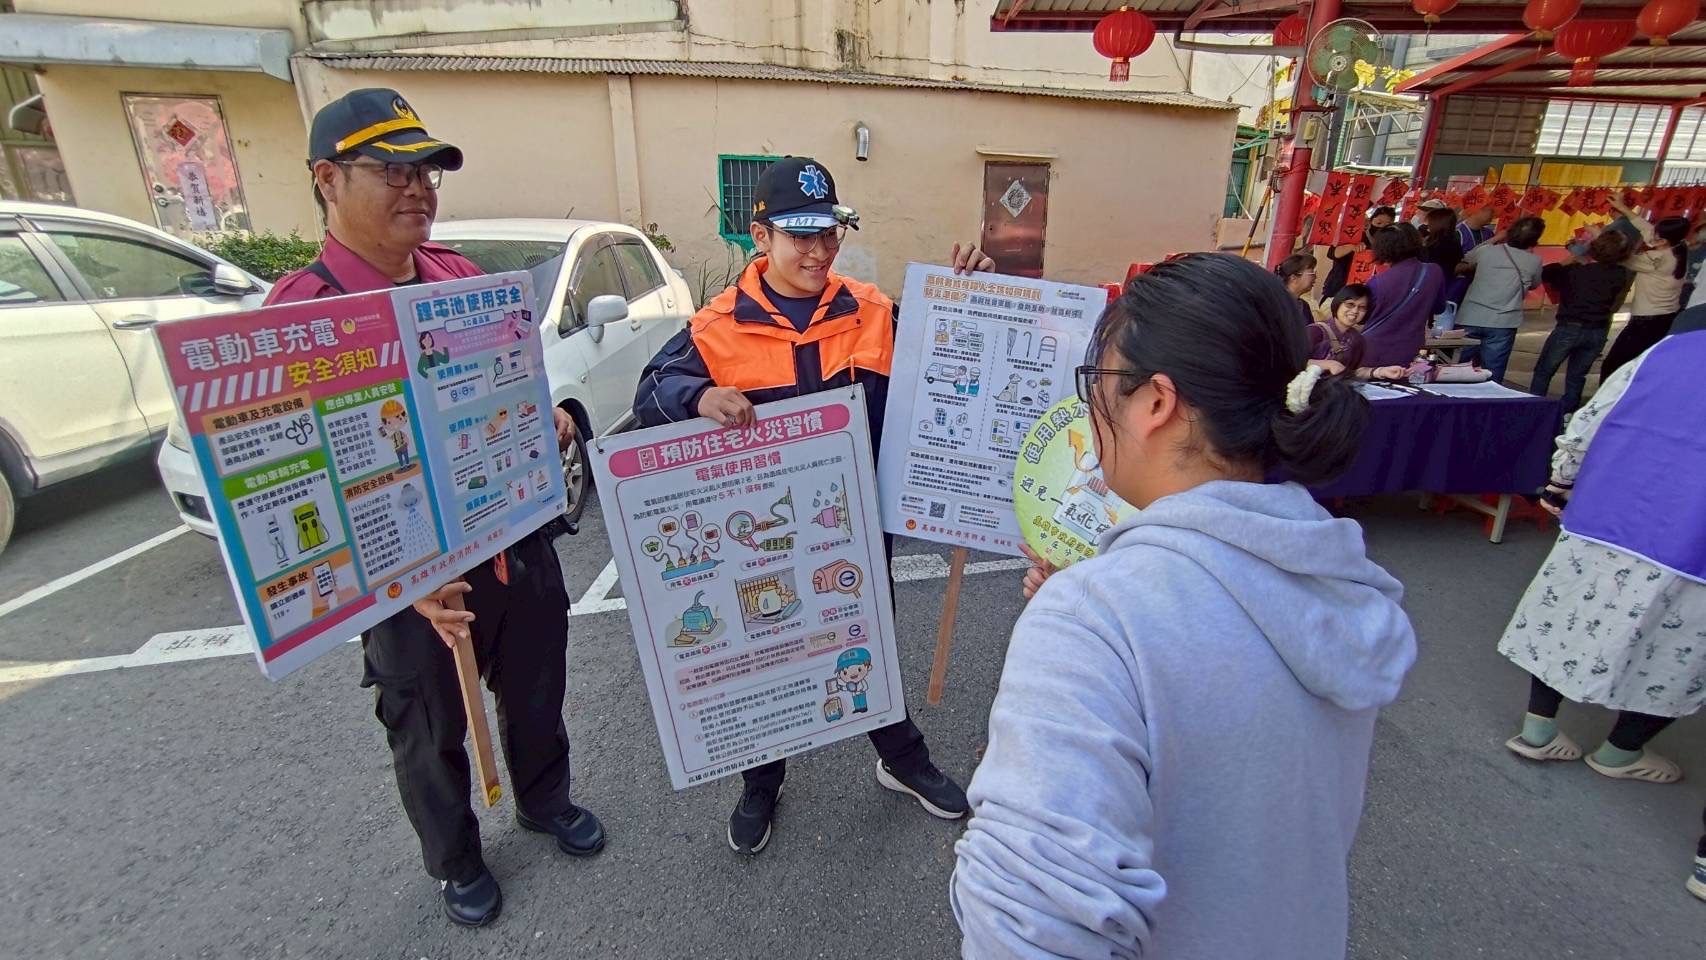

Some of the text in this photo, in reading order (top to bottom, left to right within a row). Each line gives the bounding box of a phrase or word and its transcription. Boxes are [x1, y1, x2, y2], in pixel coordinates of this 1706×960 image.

[785, 217, 817, 227] EMT
[415, 286, 522, 322] 鋰電池使用安全
[180, 317, 339, 372] 電動車充電
[287, 348, 379, 388] 安全須知
[325, 382, 397, 410] 應由專業人員安裝
[213, 397, 305, 429] 電動車及充電設備
[218, 422, 281, 445] 產品安全符合經濟
[660, 410, 824, 466] 預防住宅火災習慣
[1023, 401, 1089, 464] 使用熱水
[244, 459, 311, 489] 電動車輛充電
[695, 450, 782, 484] 電氣使用習慣
[344, 472, 394, 499] 消防安全設備
[1019, 475, 1111, 533] 避免一氧化碳
[921, 524, 986, 543] 高雄市政府消防局
[266, 571, 309, 597] 發生事故
